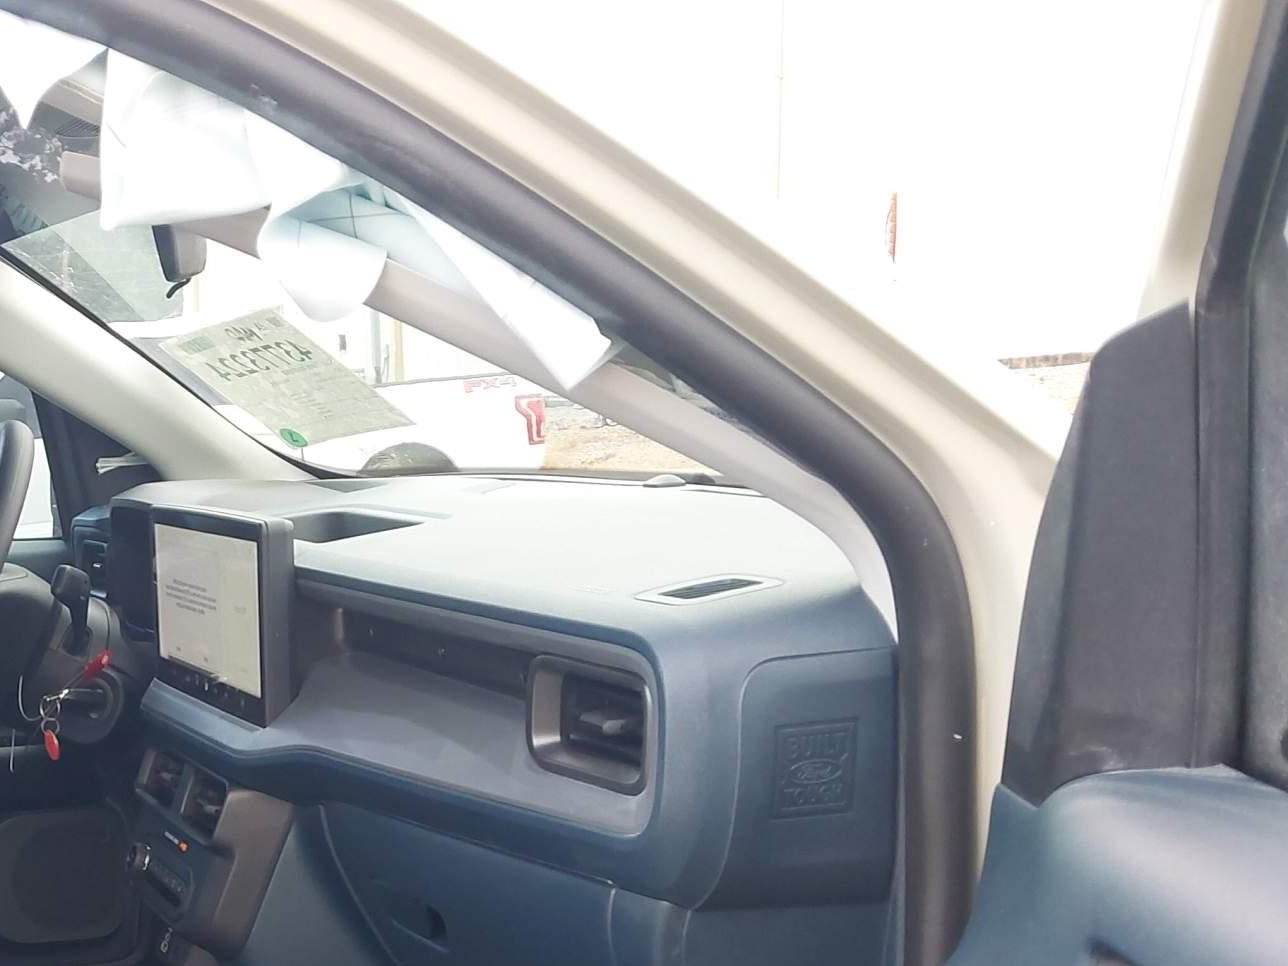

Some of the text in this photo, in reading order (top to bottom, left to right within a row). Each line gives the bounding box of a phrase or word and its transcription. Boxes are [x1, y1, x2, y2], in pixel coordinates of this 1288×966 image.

[783, 732, 849, 759] BUILT
[795, 762, 835, 781] Ford
[783, 784, 844, 805] TOUGH
